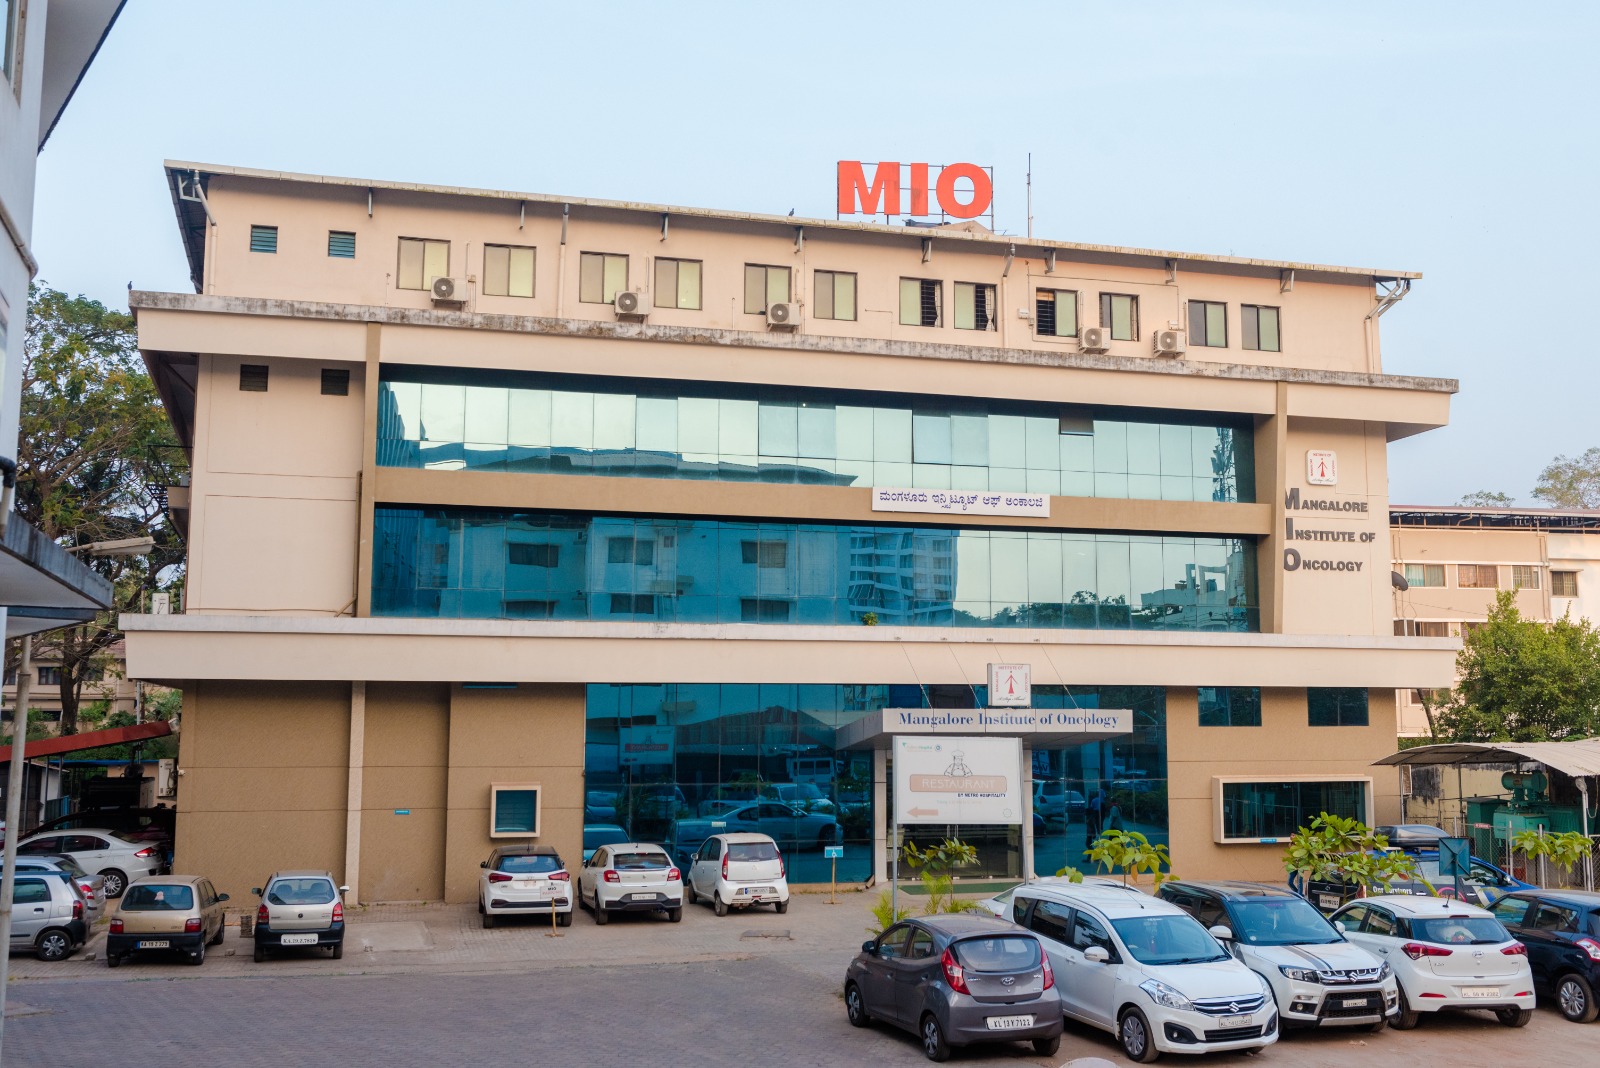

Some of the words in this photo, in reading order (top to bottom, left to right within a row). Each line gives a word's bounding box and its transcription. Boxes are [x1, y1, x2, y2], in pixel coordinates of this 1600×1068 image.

[838, 160, 992, 219] MIO
[879, 490, 928, 502] ಮಂಗಳೂರು
[1285, 487, 1368, 512] MANGALORE
[1286, 517, 1356, 542] INSTITUTE
[1360, 532, 1376, 543] OF
[1284, 547, 1363, 571] ONCOLOGY
[899, 712, 973, 728] Mangalore
[978, 712, 1035, 725] Institute
[1040, 713, 1053, 725] of
[1057, 713, 1119, 728] Oncology
[921, 779, 995, 789] RESTAURANT
